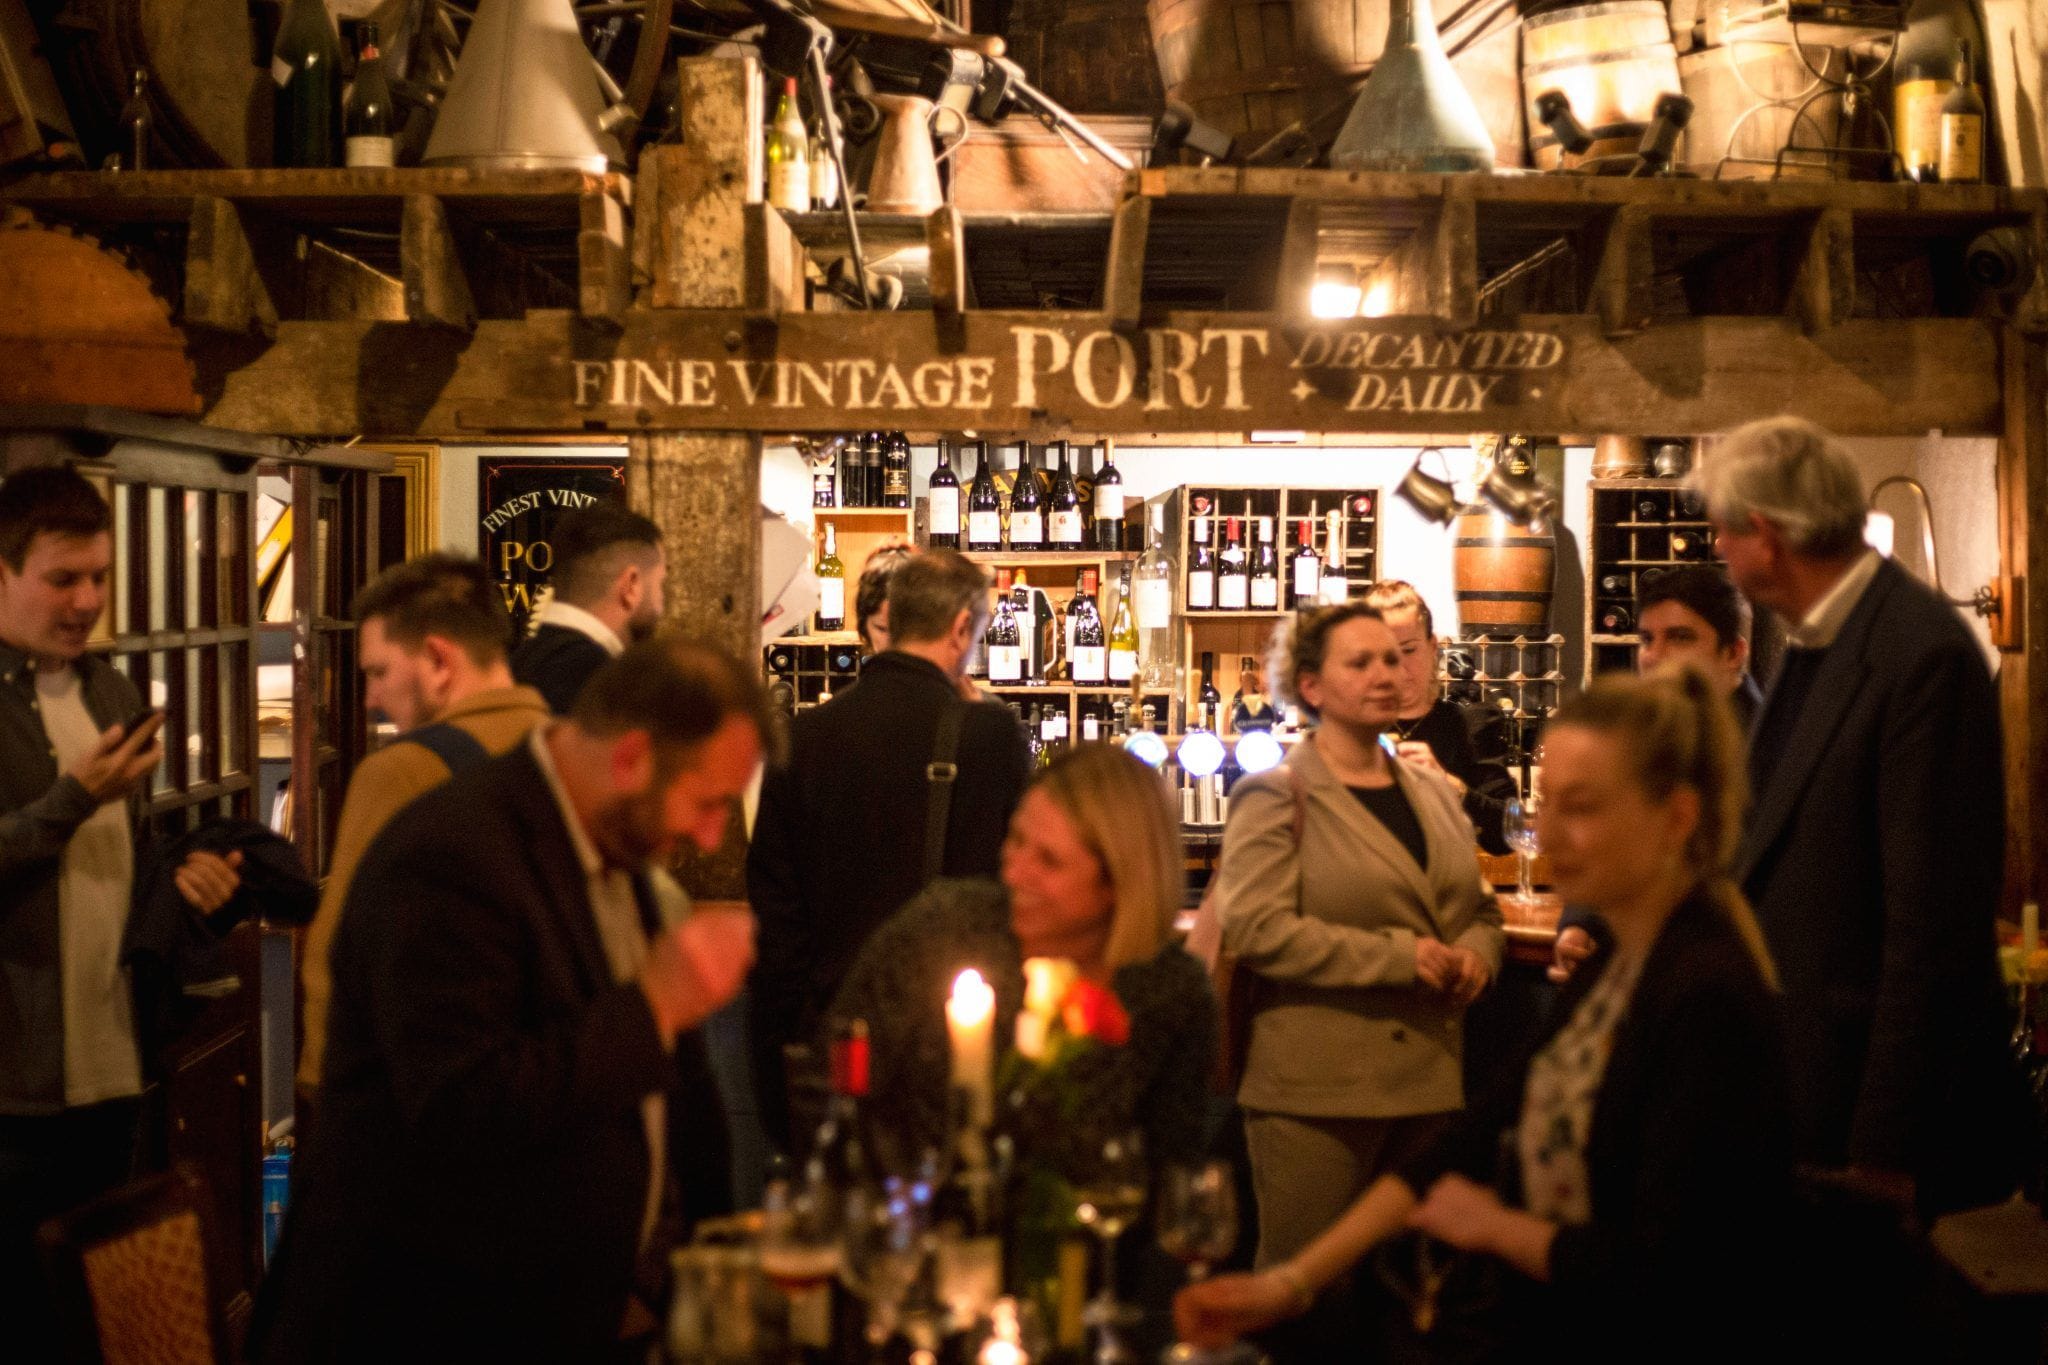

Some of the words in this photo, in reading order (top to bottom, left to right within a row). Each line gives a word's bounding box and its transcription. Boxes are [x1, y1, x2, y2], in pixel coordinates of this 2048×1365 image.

[571, 359, 716, 407] FINE
[726, 358, 995, 410] VINTAGE
[1010, 326, 1268, 411] PORT
[1290, 331, 1565, 369] DECANTED
[1345, 373, 1507, 413] DAILY
[482, 491, 542, 533] FINEST
[548, 489, 598, 510] VINT
[501, 541, 554, 572] PO
